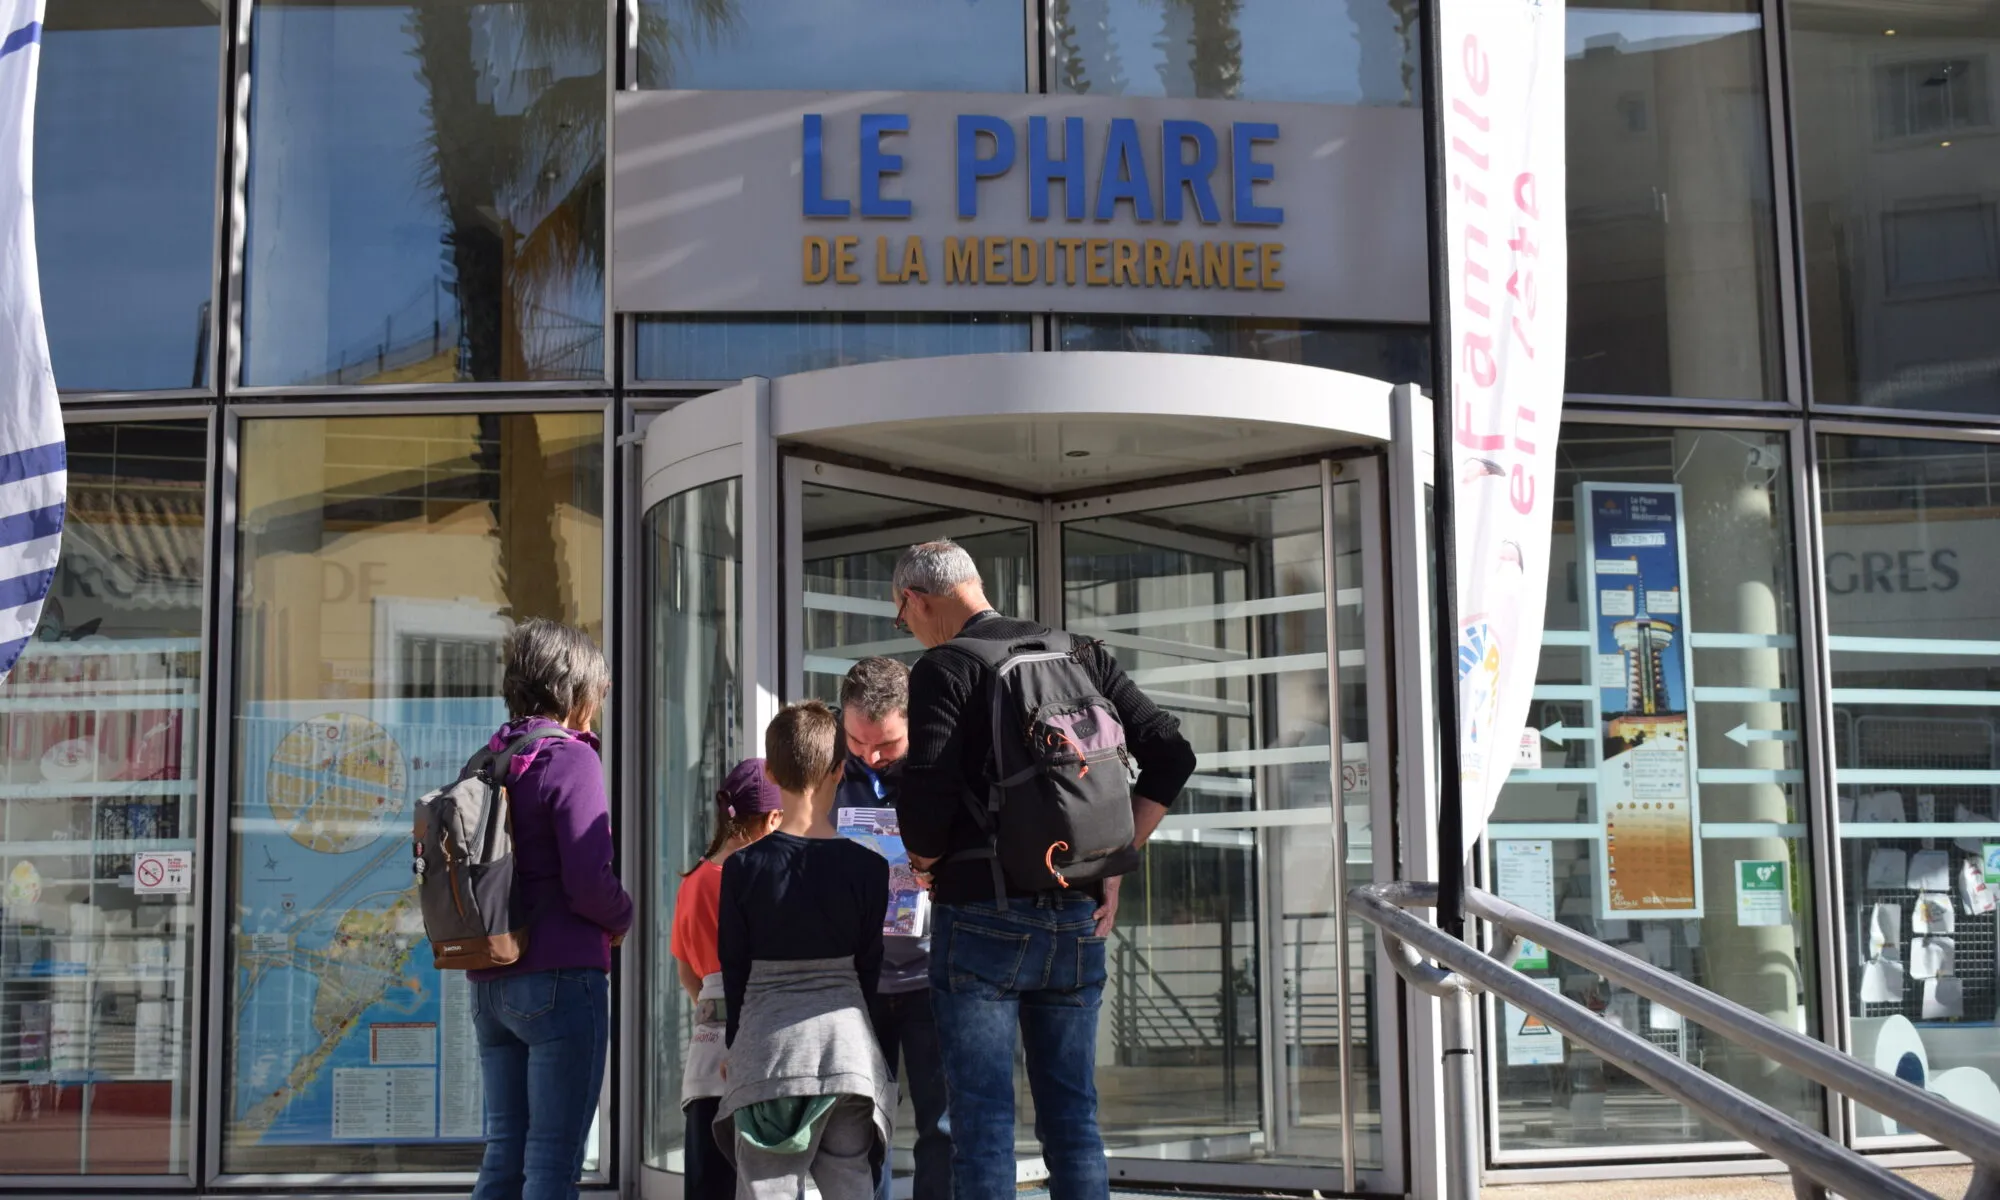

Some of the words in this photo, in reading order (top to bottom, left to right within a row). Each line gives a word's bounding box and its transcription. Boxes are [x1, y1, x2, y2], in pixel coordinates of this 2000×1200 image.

[802, 114, 912, 219] LE
[956, 114, 1286, 226] PHARE
[803, 236, 861, 285] DE
[876, 236, 929, 285] LA
[944, 236, 1286, 290] MEDITERRANEE
[1452, 33, 1505, 450] Famille
[1510, 405, 1536, 515] en
[1825, 549, 1960, 595] GRES
